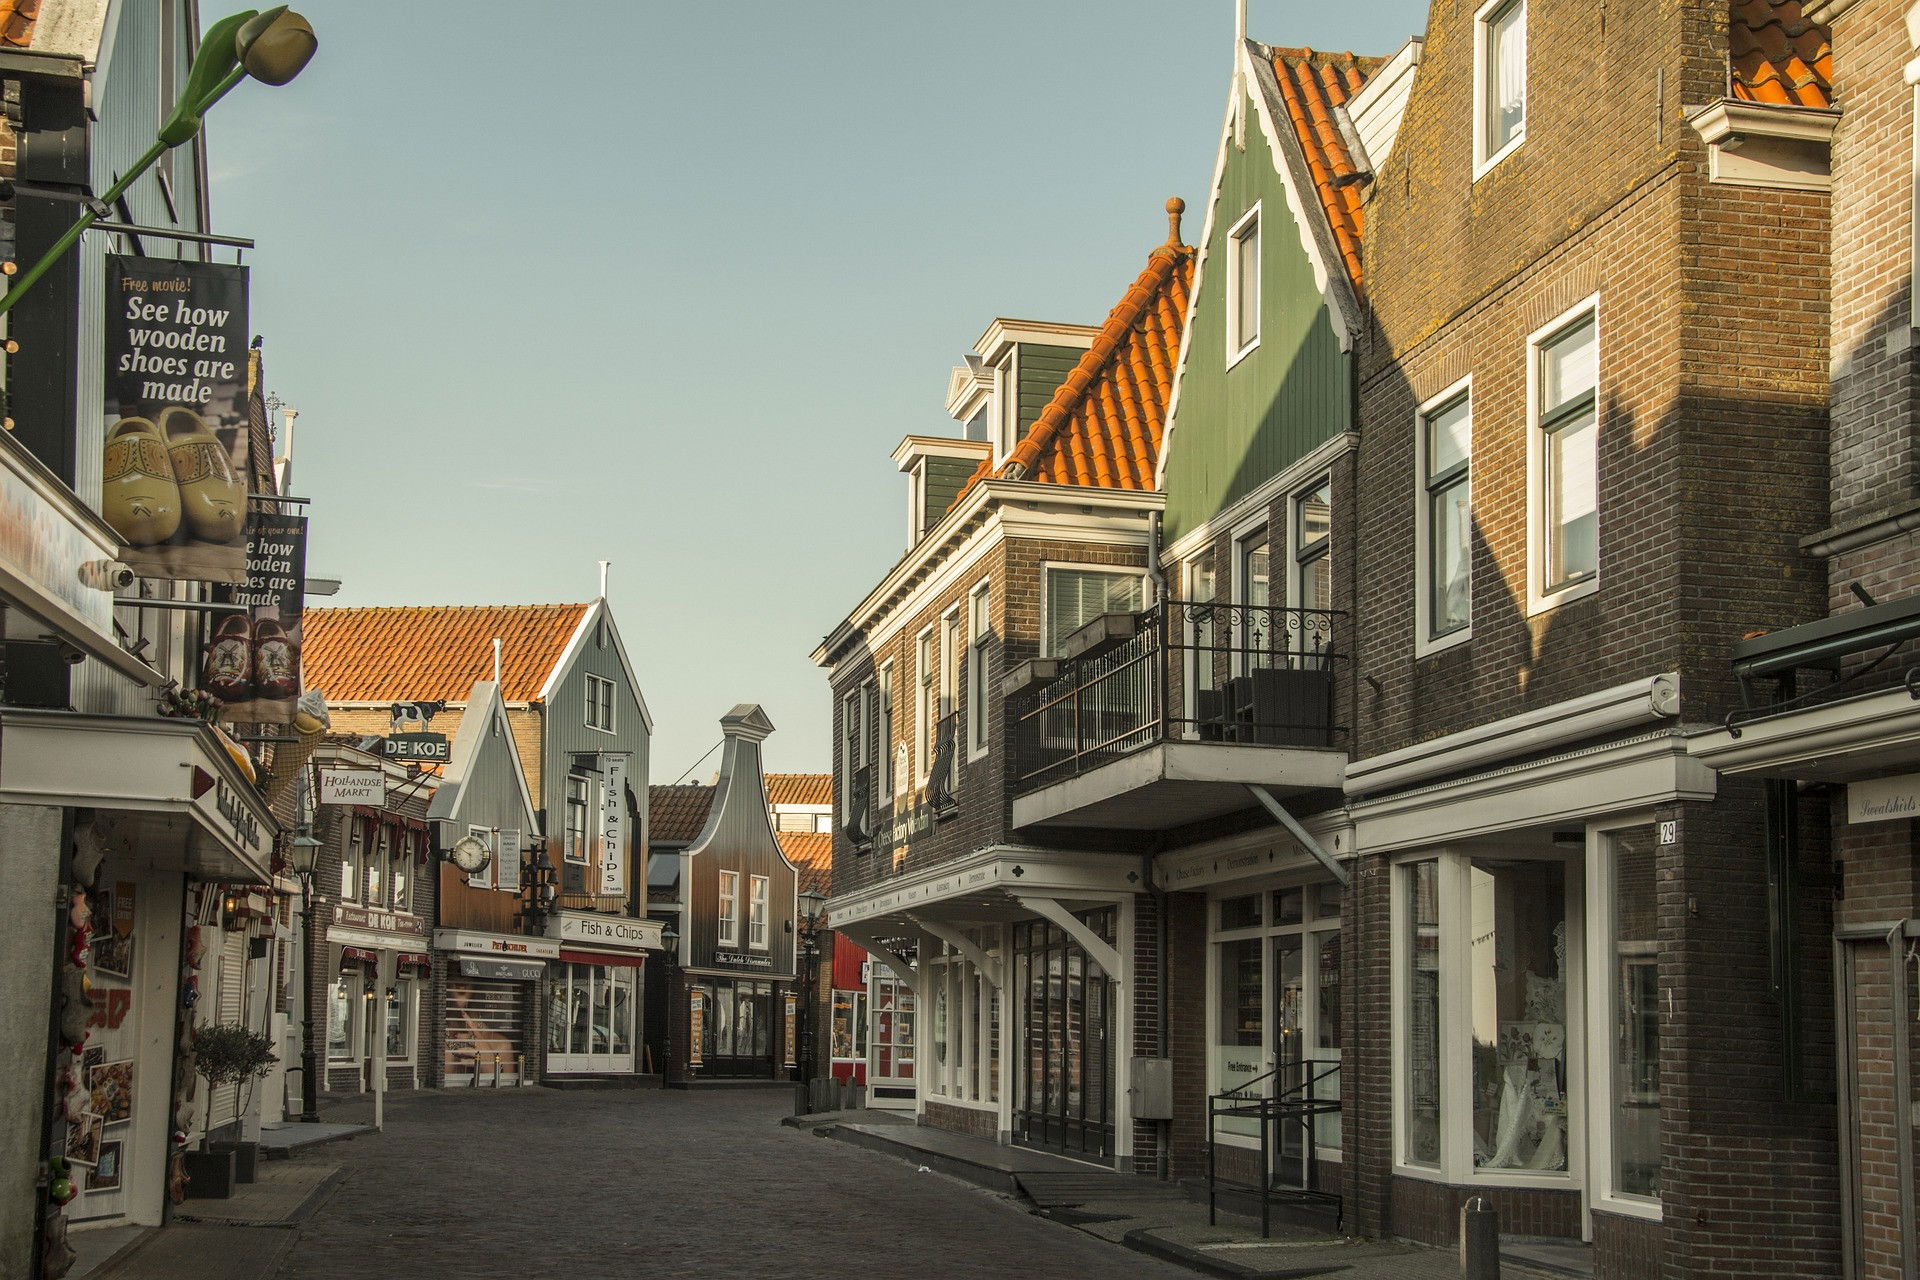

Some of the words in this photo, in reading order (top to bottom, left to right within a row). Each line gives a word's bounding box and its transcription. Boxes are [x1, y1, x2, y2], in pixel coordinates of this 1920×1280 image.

[122, 277, 149, 292] Free
[152, 277, 191, 292] movie!
[126, 296, 169, 322] See
[175, 299, 230, 327] how
[128, 326, 226, 353] wooden
[119, 347, 188, 376] shoes
[193, 359, 235, 380] are
[141, 378, 212, 404] made
[258, 538, 294, 556] how
[246, 555, 291, 573] ooden
[269, 577, 296, 590] are
[235, 590, 281, 606] made
[385, 741, 407, 754] DE
[413, 742, 446, 756] KOE
[324, 775, 382, 787] HOLLANDSE
[608, 766, 619, 808] Fish
[334, 788, 372, 798] MARKT
[1860, 796, 1916, 817] Sweatshirts
[607, 815, 618, 823] &
[1662, 823, 1674, 842] 29
[606, 829, 618, 882] Chips
[581, 920, 602, 935] Fish
[605, 925, 613, 937] &
[615, 924, 643, 940] Chips
